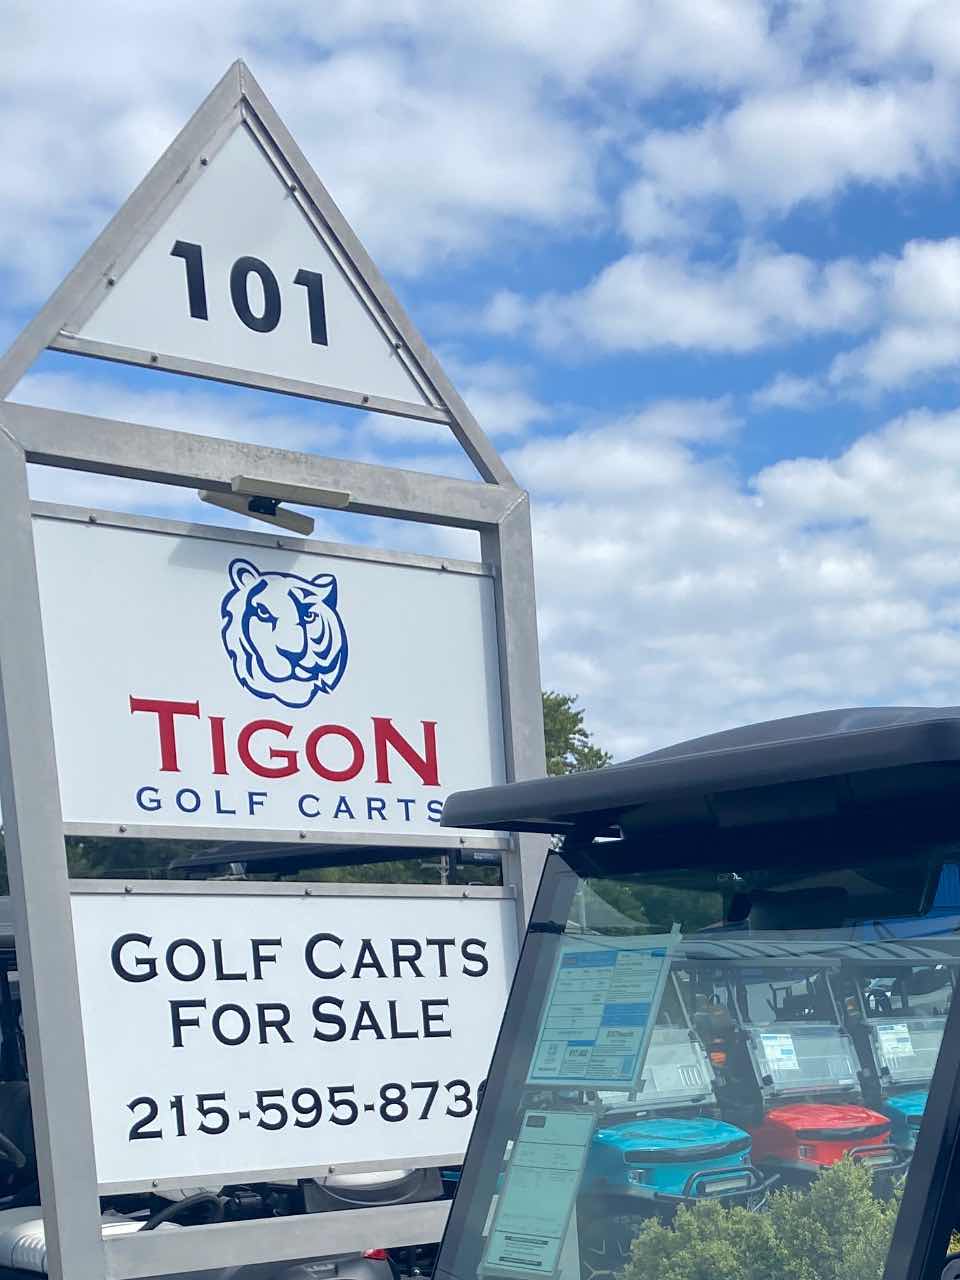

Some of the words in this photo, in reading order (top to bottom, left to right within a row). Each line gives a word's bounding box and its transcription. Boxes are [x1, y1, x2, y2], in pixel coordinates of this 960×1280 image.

[170, 240, 328, 347] 101
[129, 695, 441, 787] TIGON
[136, 786, 268, 816] GOLF
[298, 794, 443, 822] CARTS
[111, 933, 283, 983] GOLF
[305, 932, 490, 979] CARTS
[168, 998, 294, 1048] FOR
[312, 995, 452, 1042] SALE
